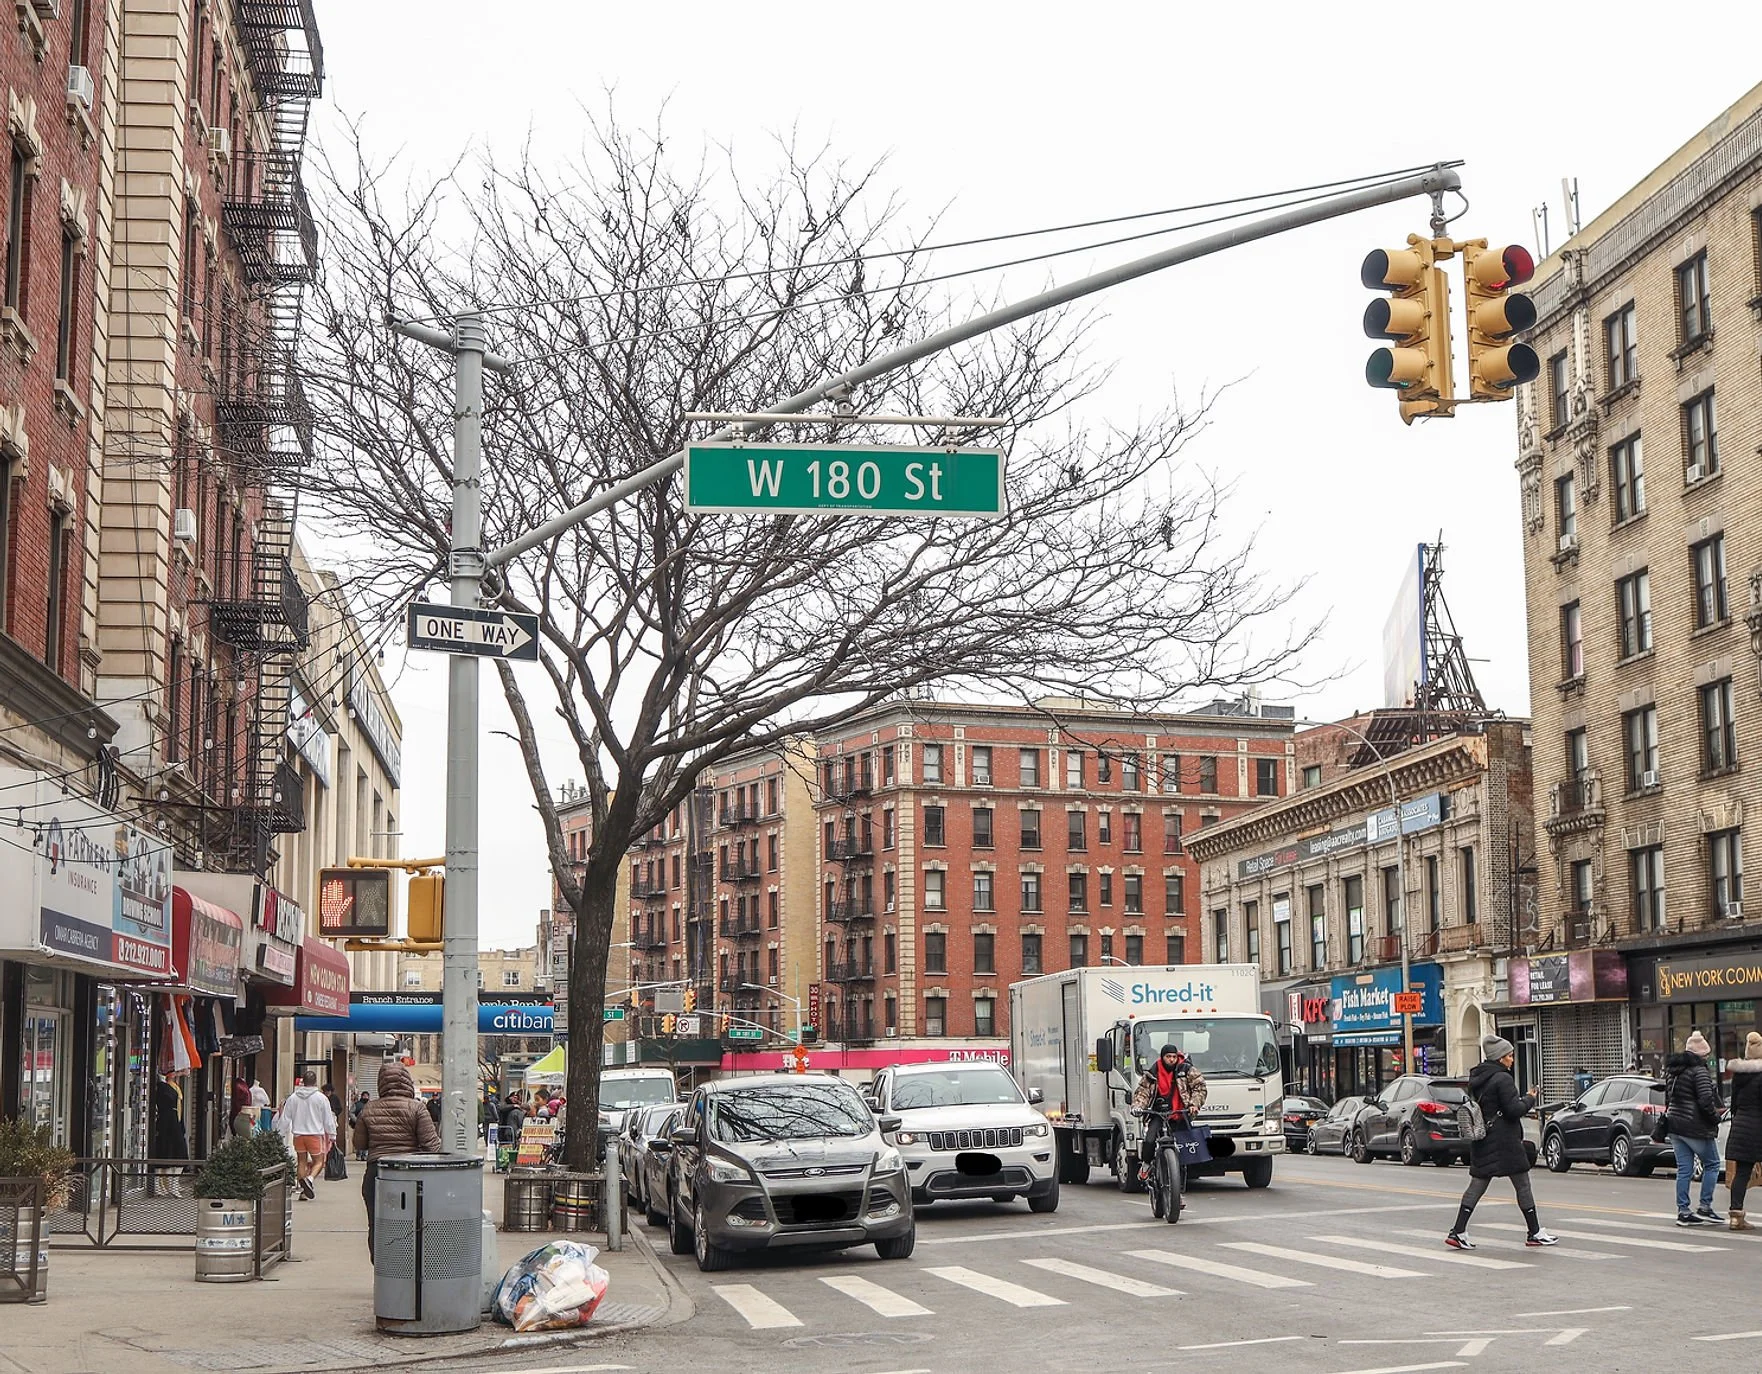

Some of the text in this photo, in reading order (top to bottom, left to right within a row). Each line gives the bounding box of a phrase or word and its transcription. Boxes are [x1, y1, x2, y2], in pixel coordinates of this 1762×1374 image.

[747, 459, 943, 501] W 180 St
[427, 618, 519, 645] ONE WAY
[68, 831, 110, 874] FARMERS
[1245, 858, 1259, 873] Retail
[1259, 857, 1274, 872] Space
[68, 870, 98, 895] INSURANCE
[1539, 980, 1553, 989] LEASE
[1671, 972, 1693, 989] NEW
[1695, 969, 1724, 987] YORK
[362, 995, 434, 1004] Branch Entrance
[1131, 982, 1214, 1004] Shred-it
[1342, 986, 1389, 1009] Fish Market
[607, 1011, 614, 1019] ST
[810, 1001, 818, 1028] PHOTO
[1303, 997, 1327, 1023] KFC
[493, 1012, 554, 1030] citiban
[1583, 1079, 1590, 1089] P
[1200, 1104, 1230, 1112] SUZU
[222, 1213, 235, 1226] M
